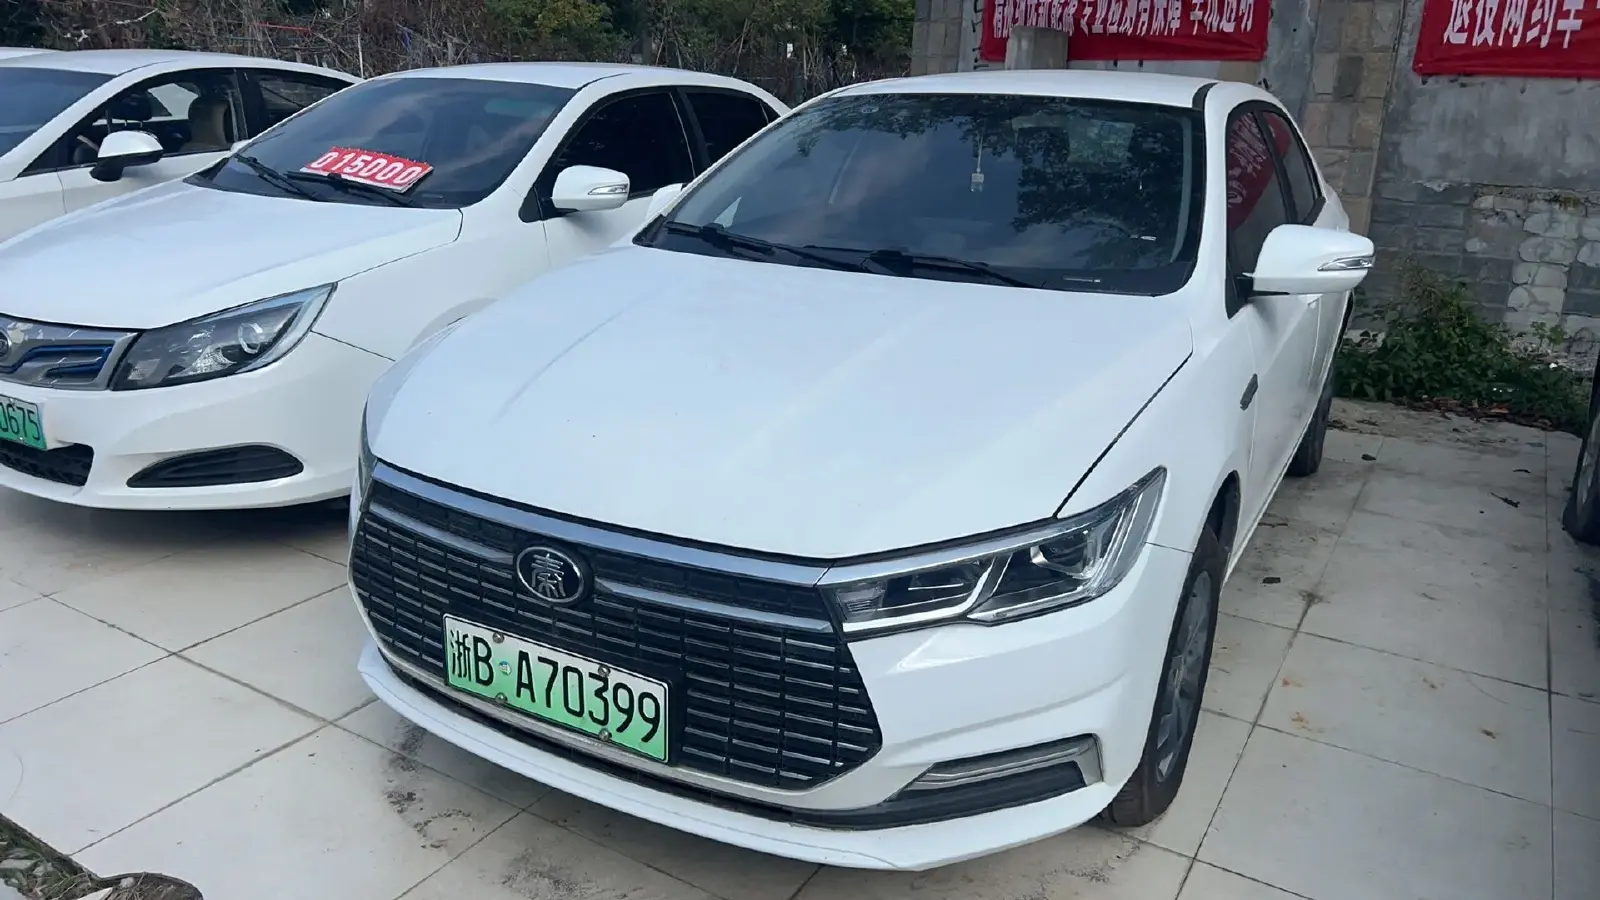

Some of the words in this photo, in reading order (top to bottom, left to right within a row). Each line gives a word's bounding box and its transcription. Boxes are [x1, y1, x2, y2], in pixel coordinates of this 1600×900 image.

[1443, 0, 1584, 49] 退役网约车
[531, 553, 567, 599] 秦
